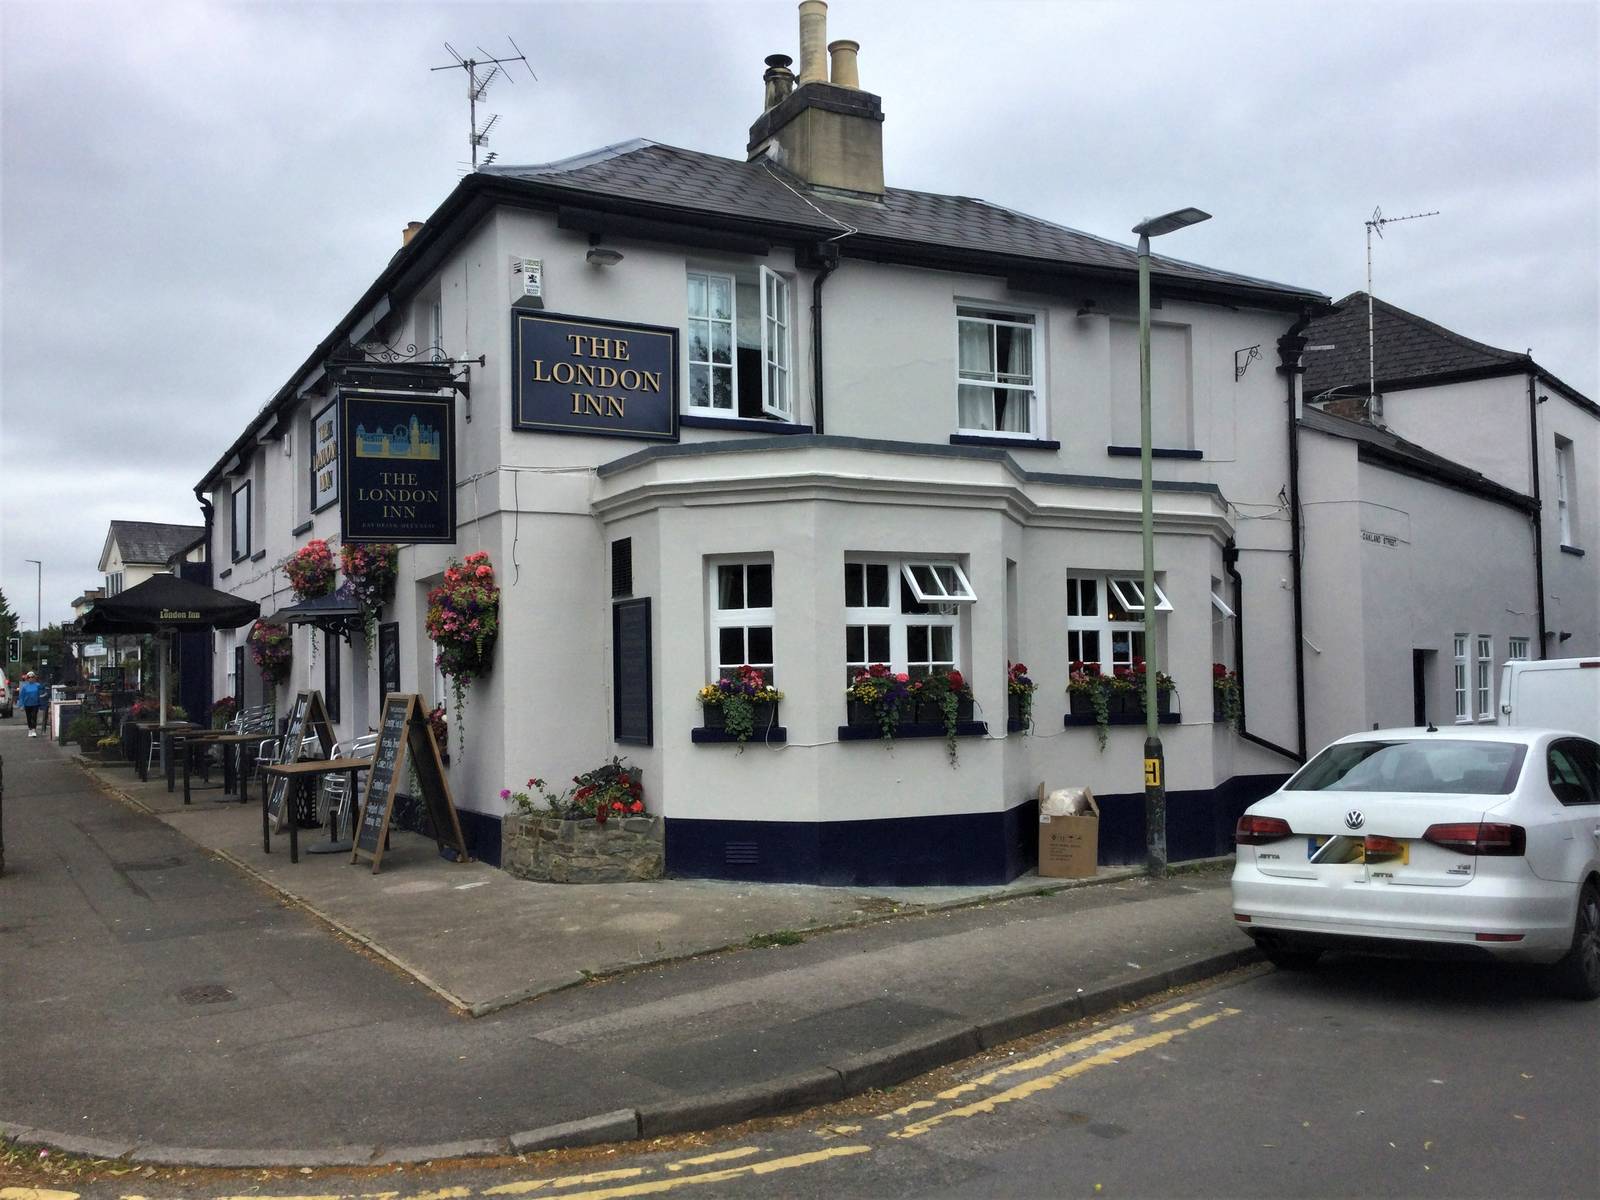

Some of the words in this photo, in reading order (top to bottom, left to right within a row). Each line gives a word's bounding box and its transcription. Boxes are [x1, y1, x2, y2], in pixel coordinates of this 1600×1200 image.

[567, 334, 630, 361] THE
[533, 359, 662, 393] LONDON
[571, 392, 627, 418] INN
[379, 472, 418, 486] THE
[358, 488, 440, 503] LONDON
[383, 505, 416, 518] INN
[160, 610, 187, 619] London
[188, 610, 200, 619] Inn
[1345, 809, 1365, 830] VW
